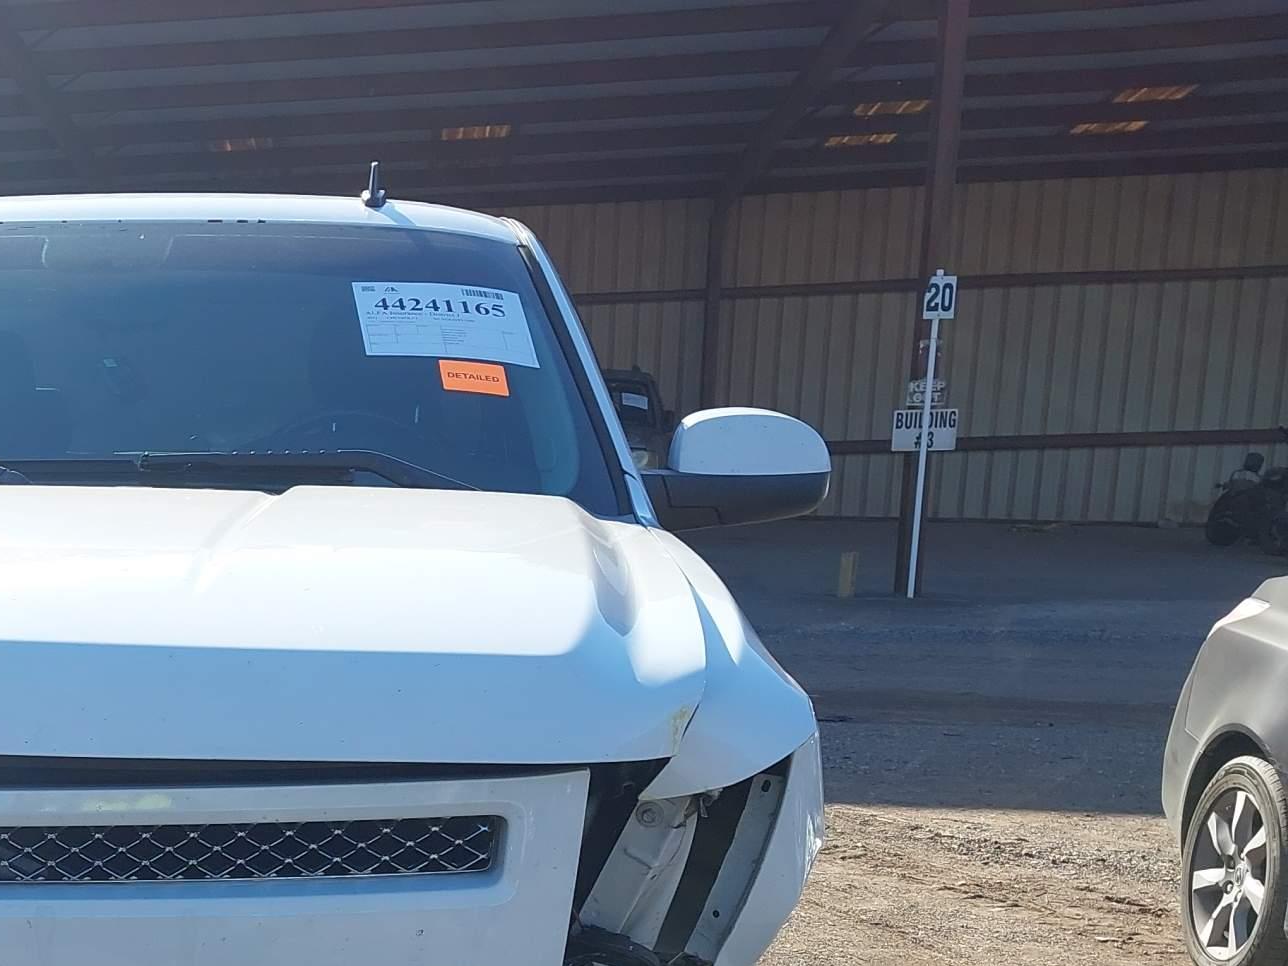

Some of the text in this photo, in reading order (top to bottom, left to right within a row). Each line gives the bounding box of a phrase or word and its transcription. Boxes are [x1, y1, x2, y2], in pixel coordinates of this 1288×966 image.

[374, 297, 505, 318] 44241165
[926, 282, 954, 312] 20
[447, 371, 500, 383] DETAILED
